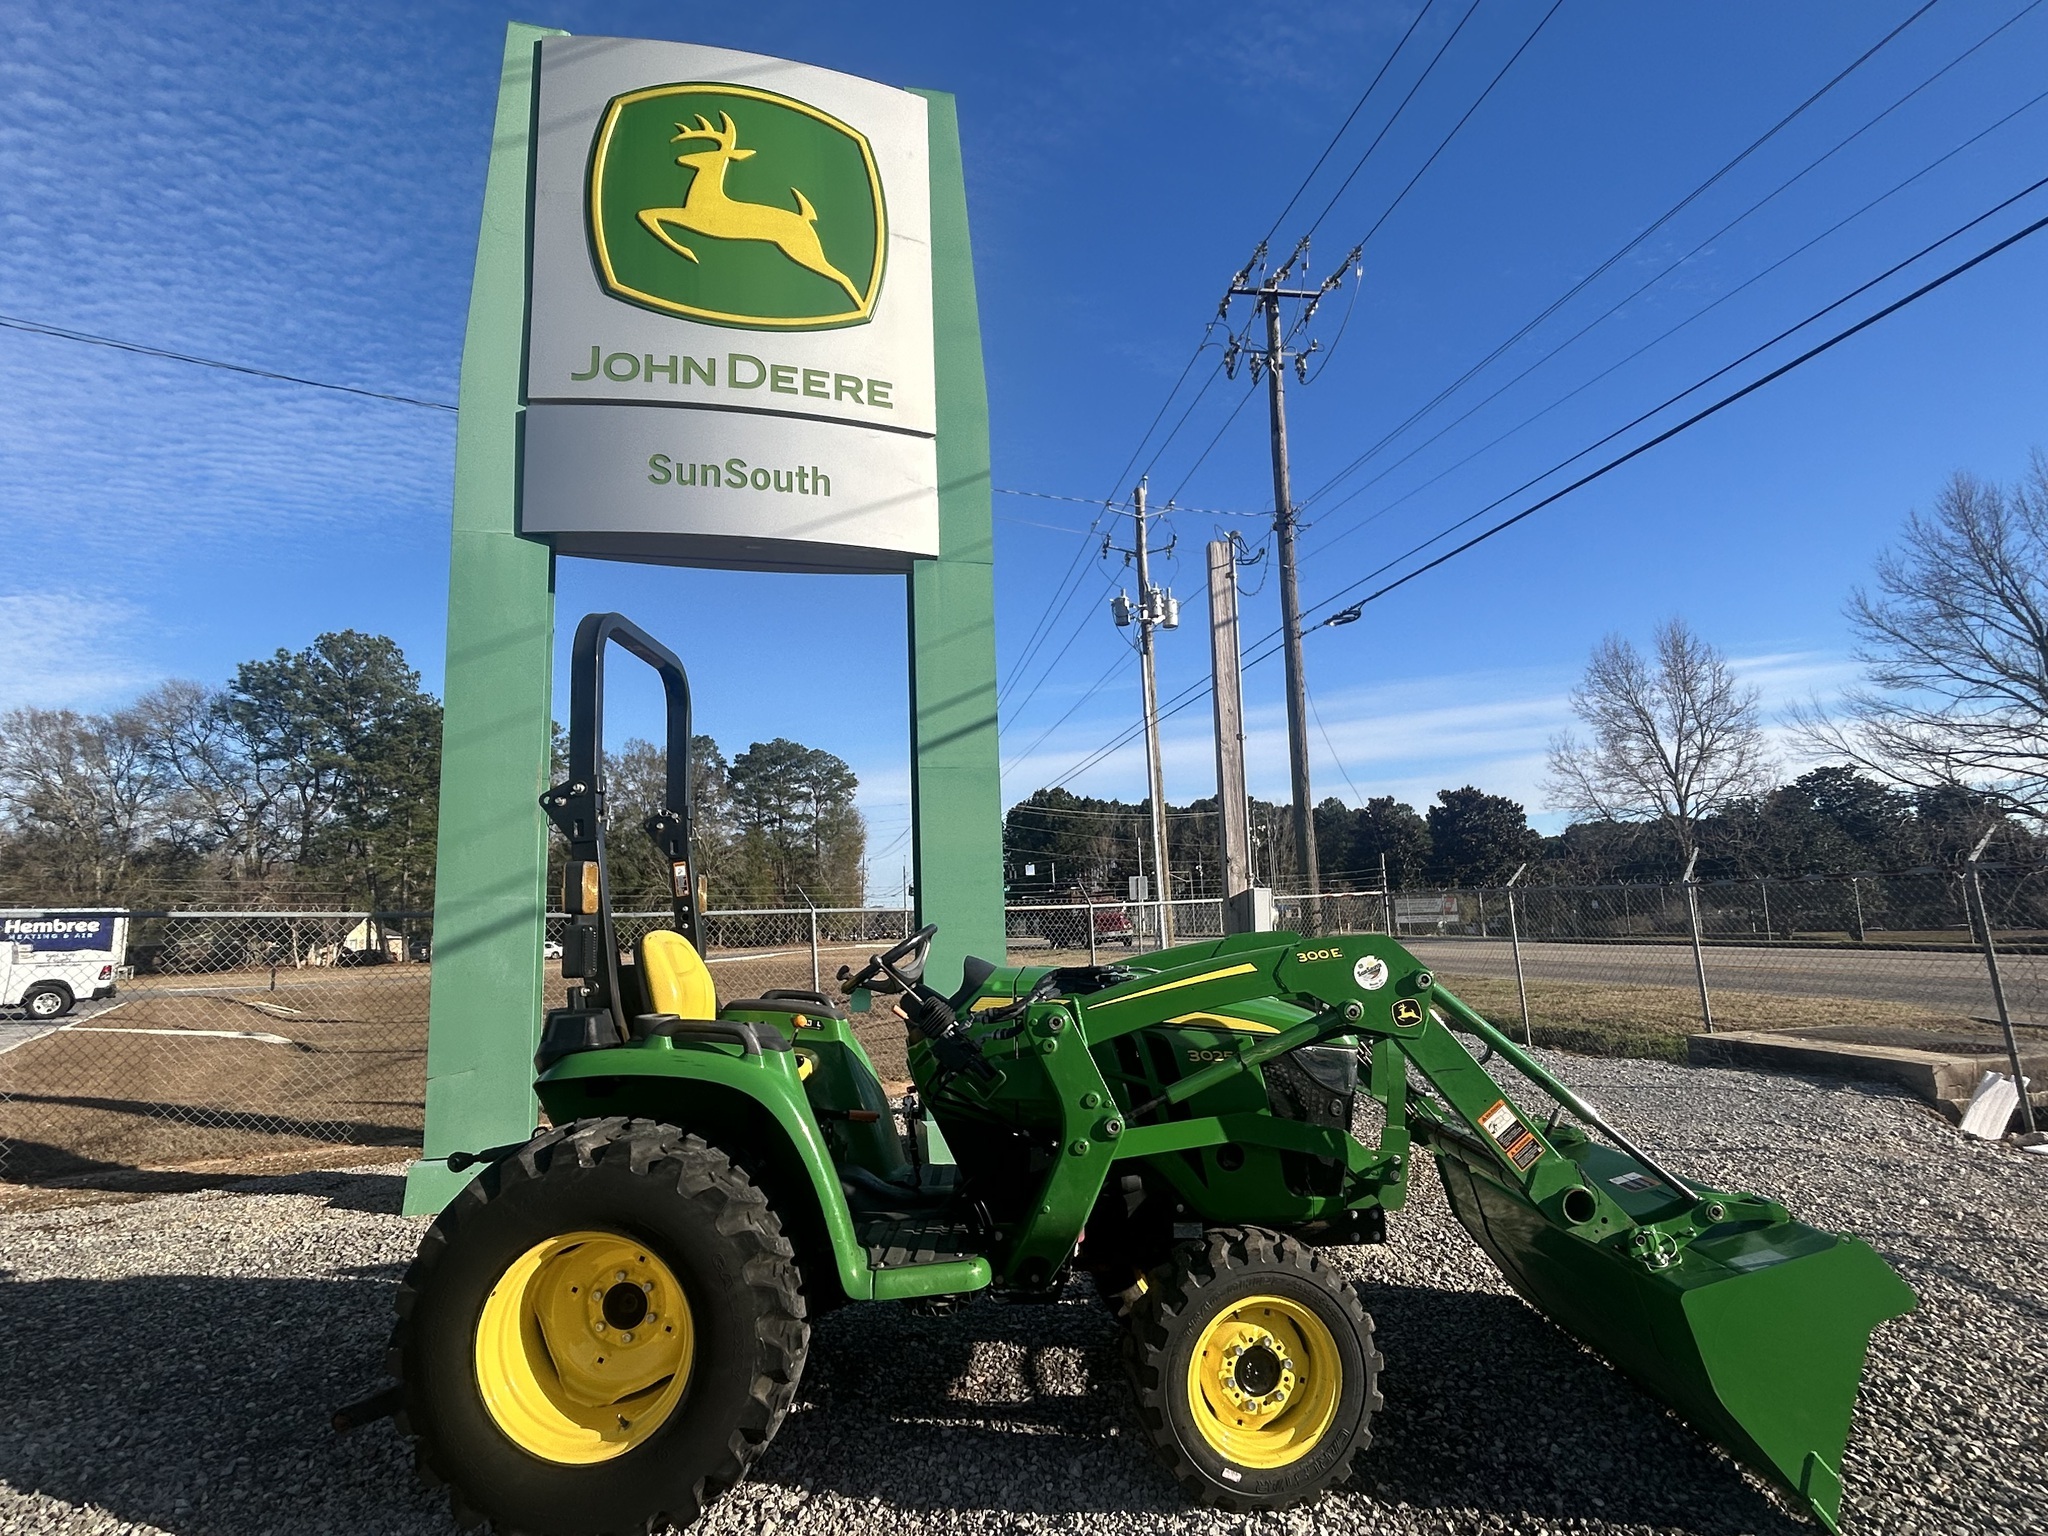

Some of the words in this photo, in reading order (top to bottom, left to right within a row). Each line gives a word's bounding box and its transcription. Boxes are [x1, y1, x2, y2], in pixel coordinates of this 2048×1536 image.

[571, 346, 716, 386] JOHN
[728, 353, 893, 410] DEERE
[648, 453, 831, 497] SunSouth
[4, 918, 100, 933] Hembree
